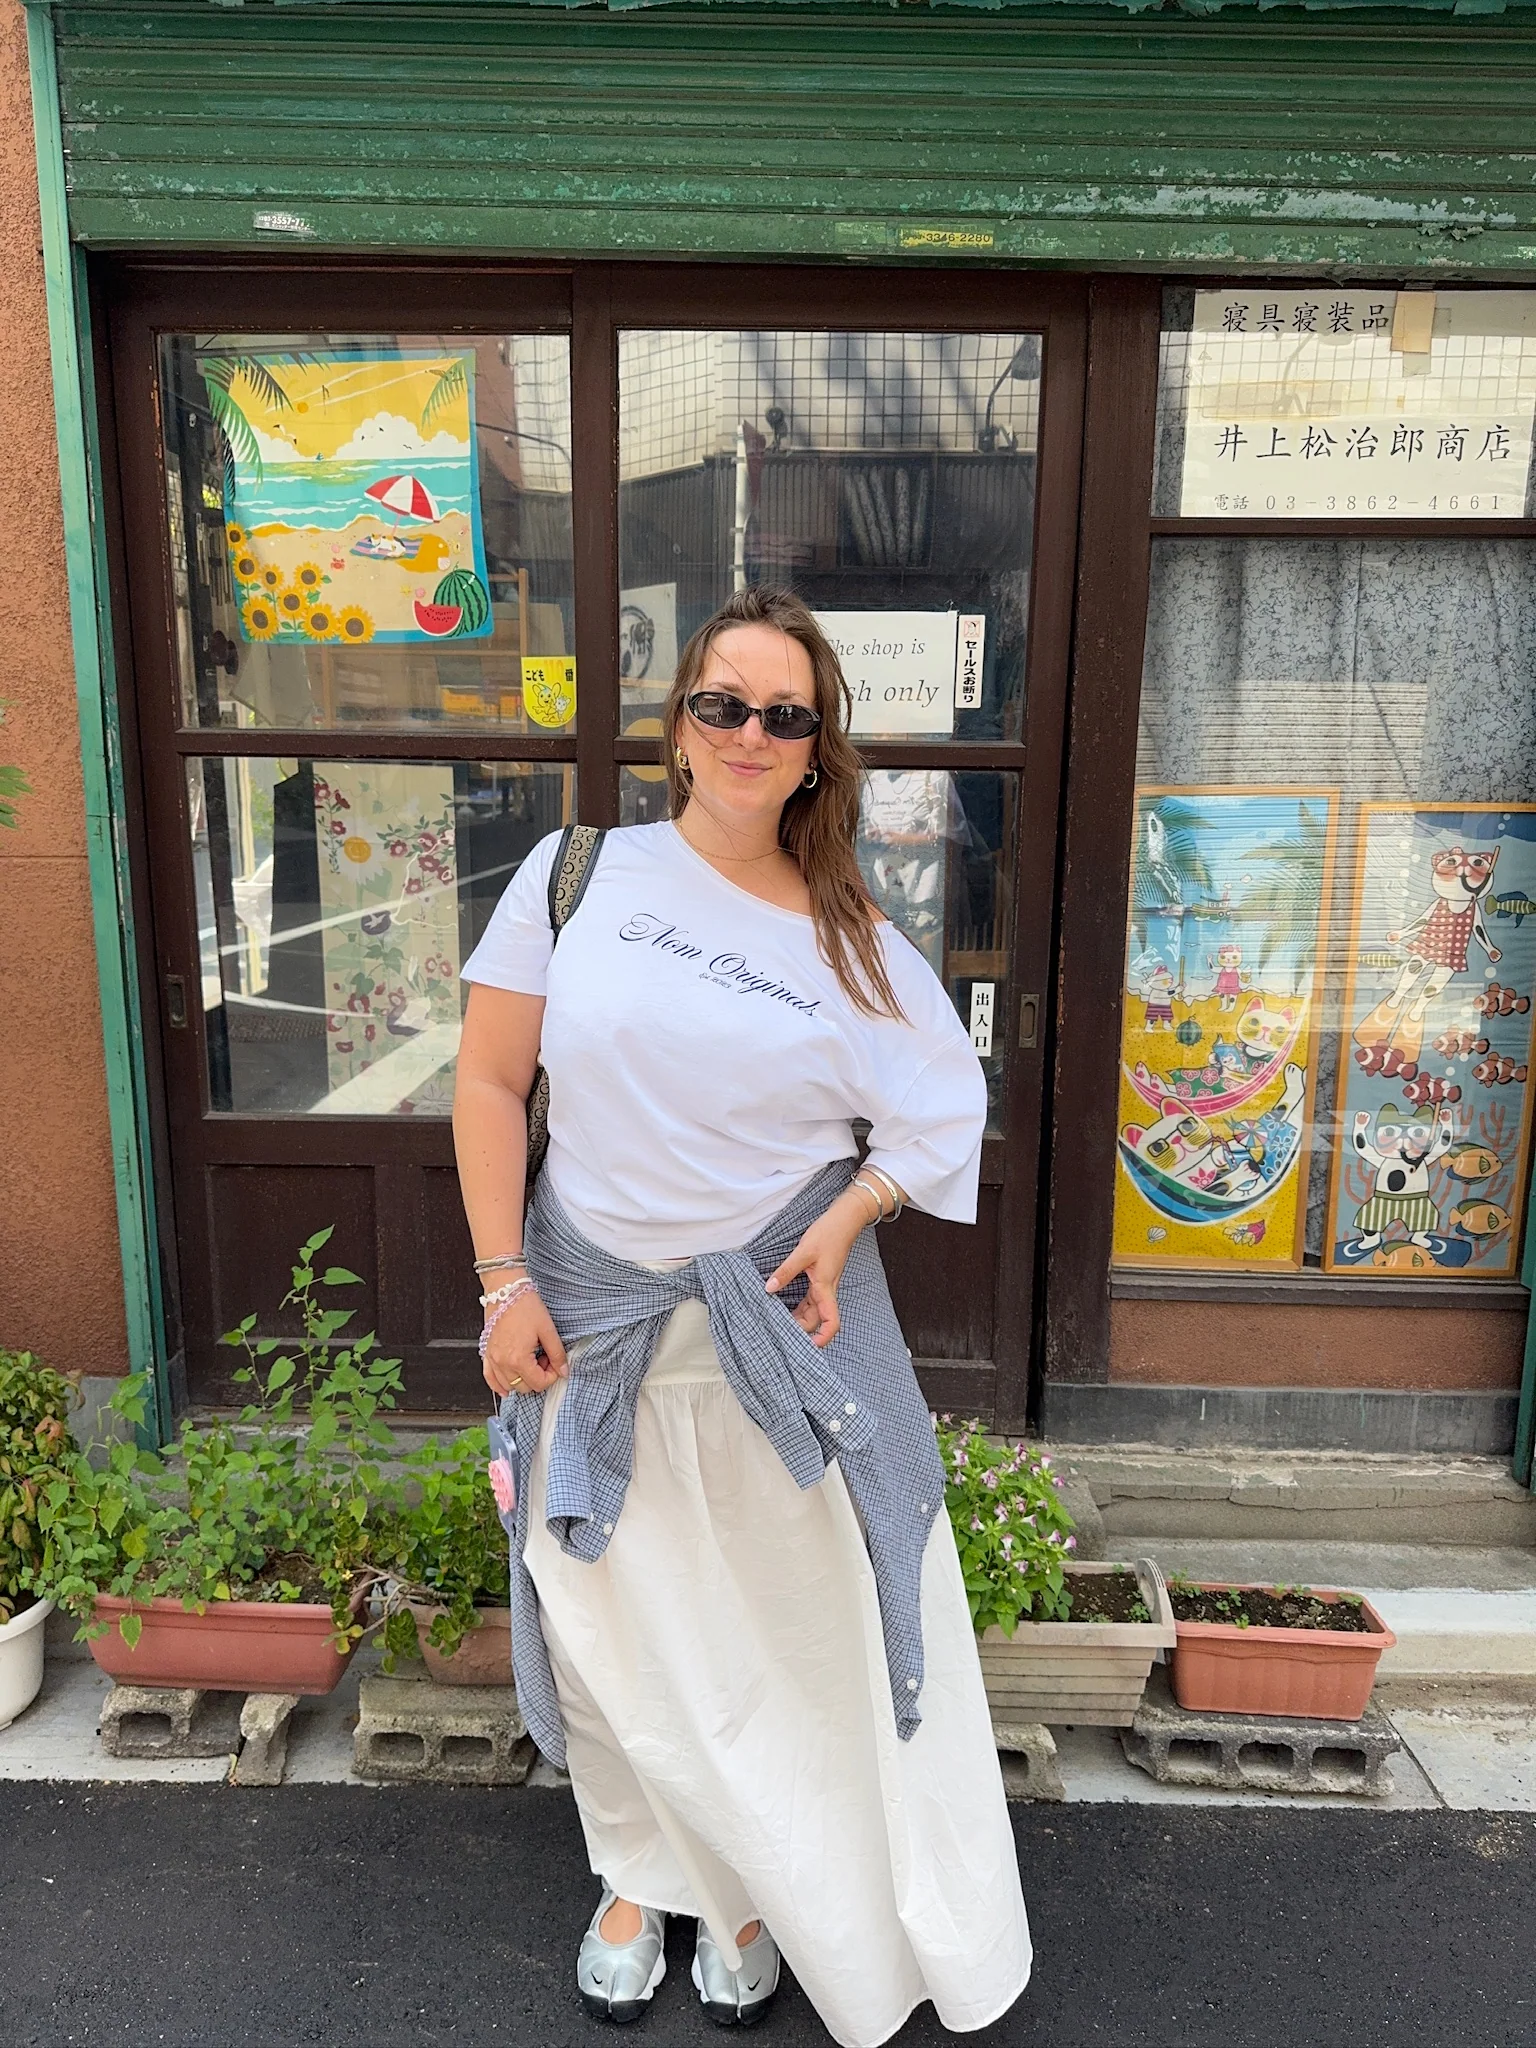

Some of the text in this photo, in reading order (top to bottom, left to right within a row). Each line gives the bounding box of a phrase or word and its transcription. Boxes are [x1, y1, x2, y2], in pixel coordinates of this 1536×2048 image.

[1223, 301, 1389, 332] 寝具寝装品
[1214, 423, 1511, 463] 井上松治郎商店
[1214, 493, 1500, 511] 電話 03-3862-4661
[861, 638, 903, 659] shop
[911, 638, 925, 655] is
[962, 640, 978, 704] セールスお断り
[884, 679, 940, 708] only
[619, 912, 823, 1018] Nom Originals
[975, 992, 989, 1048] 出入口
